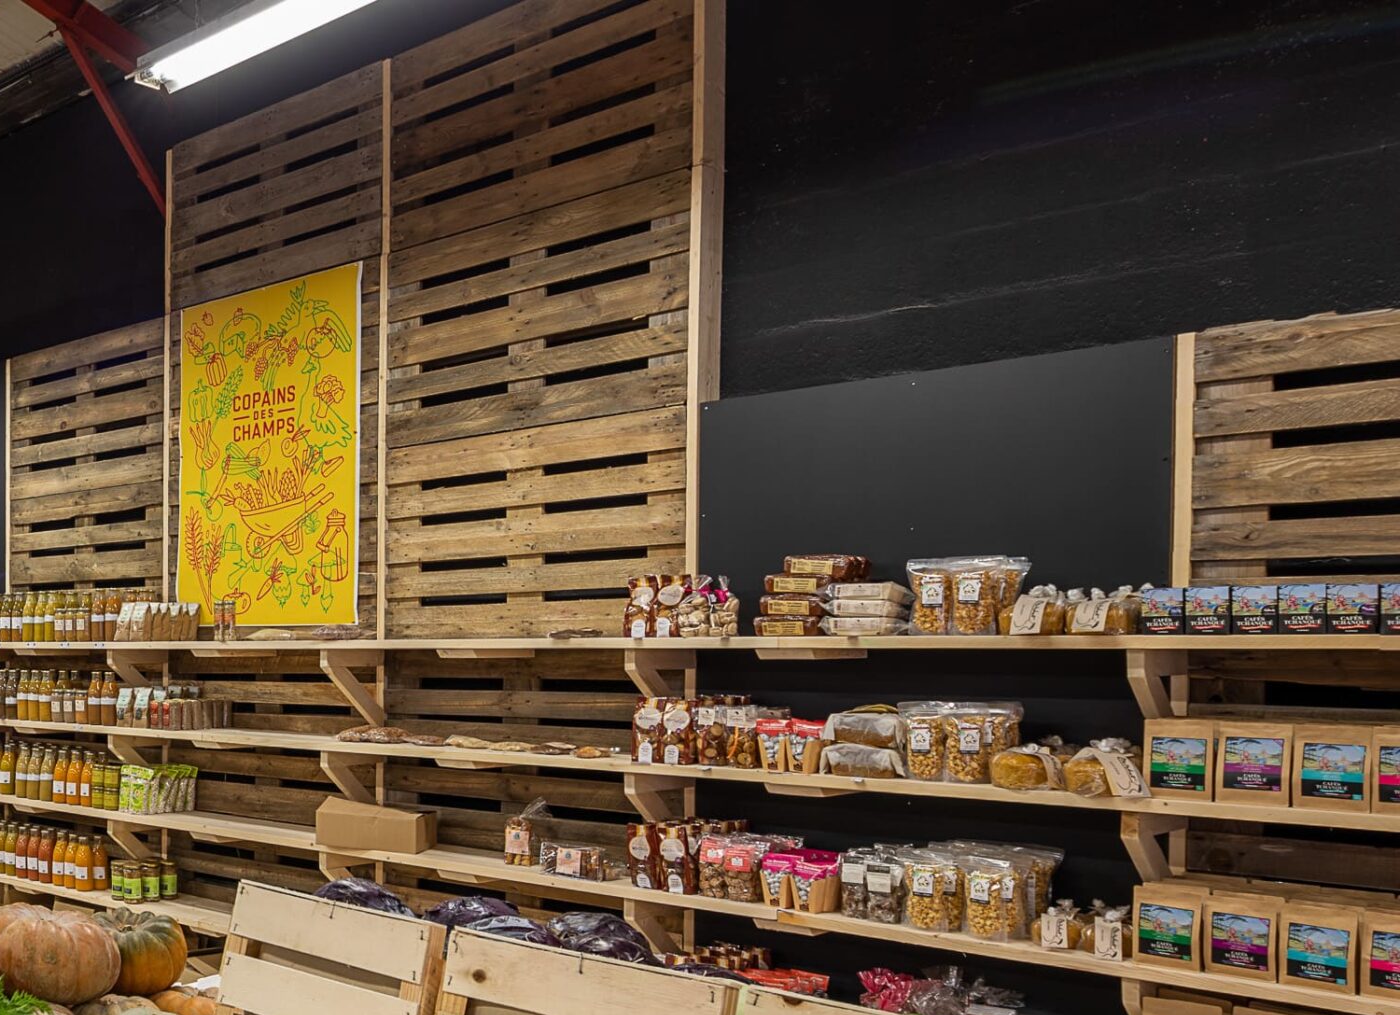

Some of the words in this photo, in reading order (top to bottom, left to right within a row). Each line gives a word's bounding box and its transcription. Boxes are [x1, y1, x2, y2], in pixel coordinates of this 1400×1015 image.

[233, 385, 296, 412] COPAINS
[254, 409, 273, 420] DES
[233, 417, 295, 442] CHAMPS
